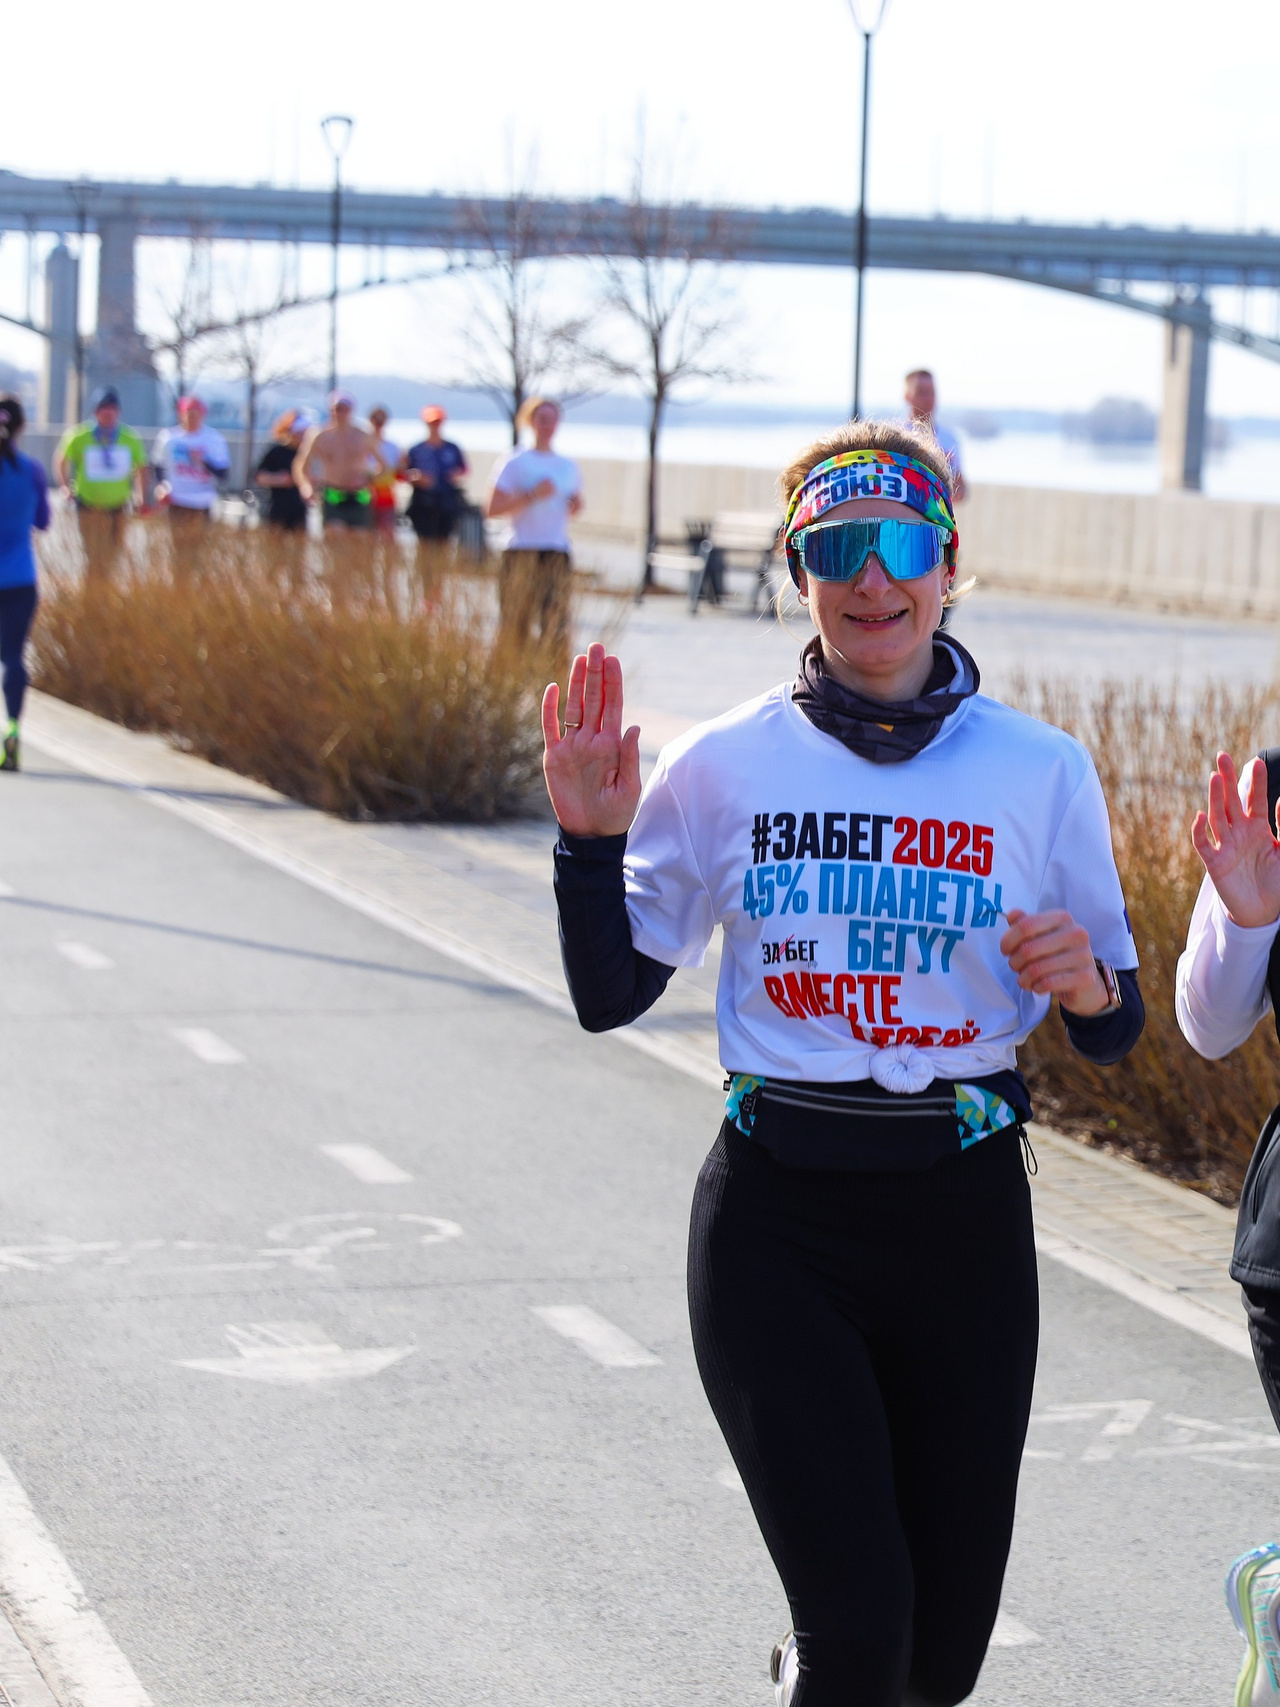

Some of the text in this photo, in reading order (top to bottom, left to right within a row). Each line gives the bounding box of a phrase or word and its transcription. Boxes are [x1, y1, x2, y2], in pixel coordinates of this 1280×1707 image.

[751, 812, 994, 876] #ЗАБЕГ2025
[742, 863, 1003, 928] 45% ПЛАНЕТЫ
[761, 940, 819, 965] ЗАБЕГ
[847, 919, 965, 974] БЕГУТ
[763, 971, 903, 1025] ВМЕСТЕ
